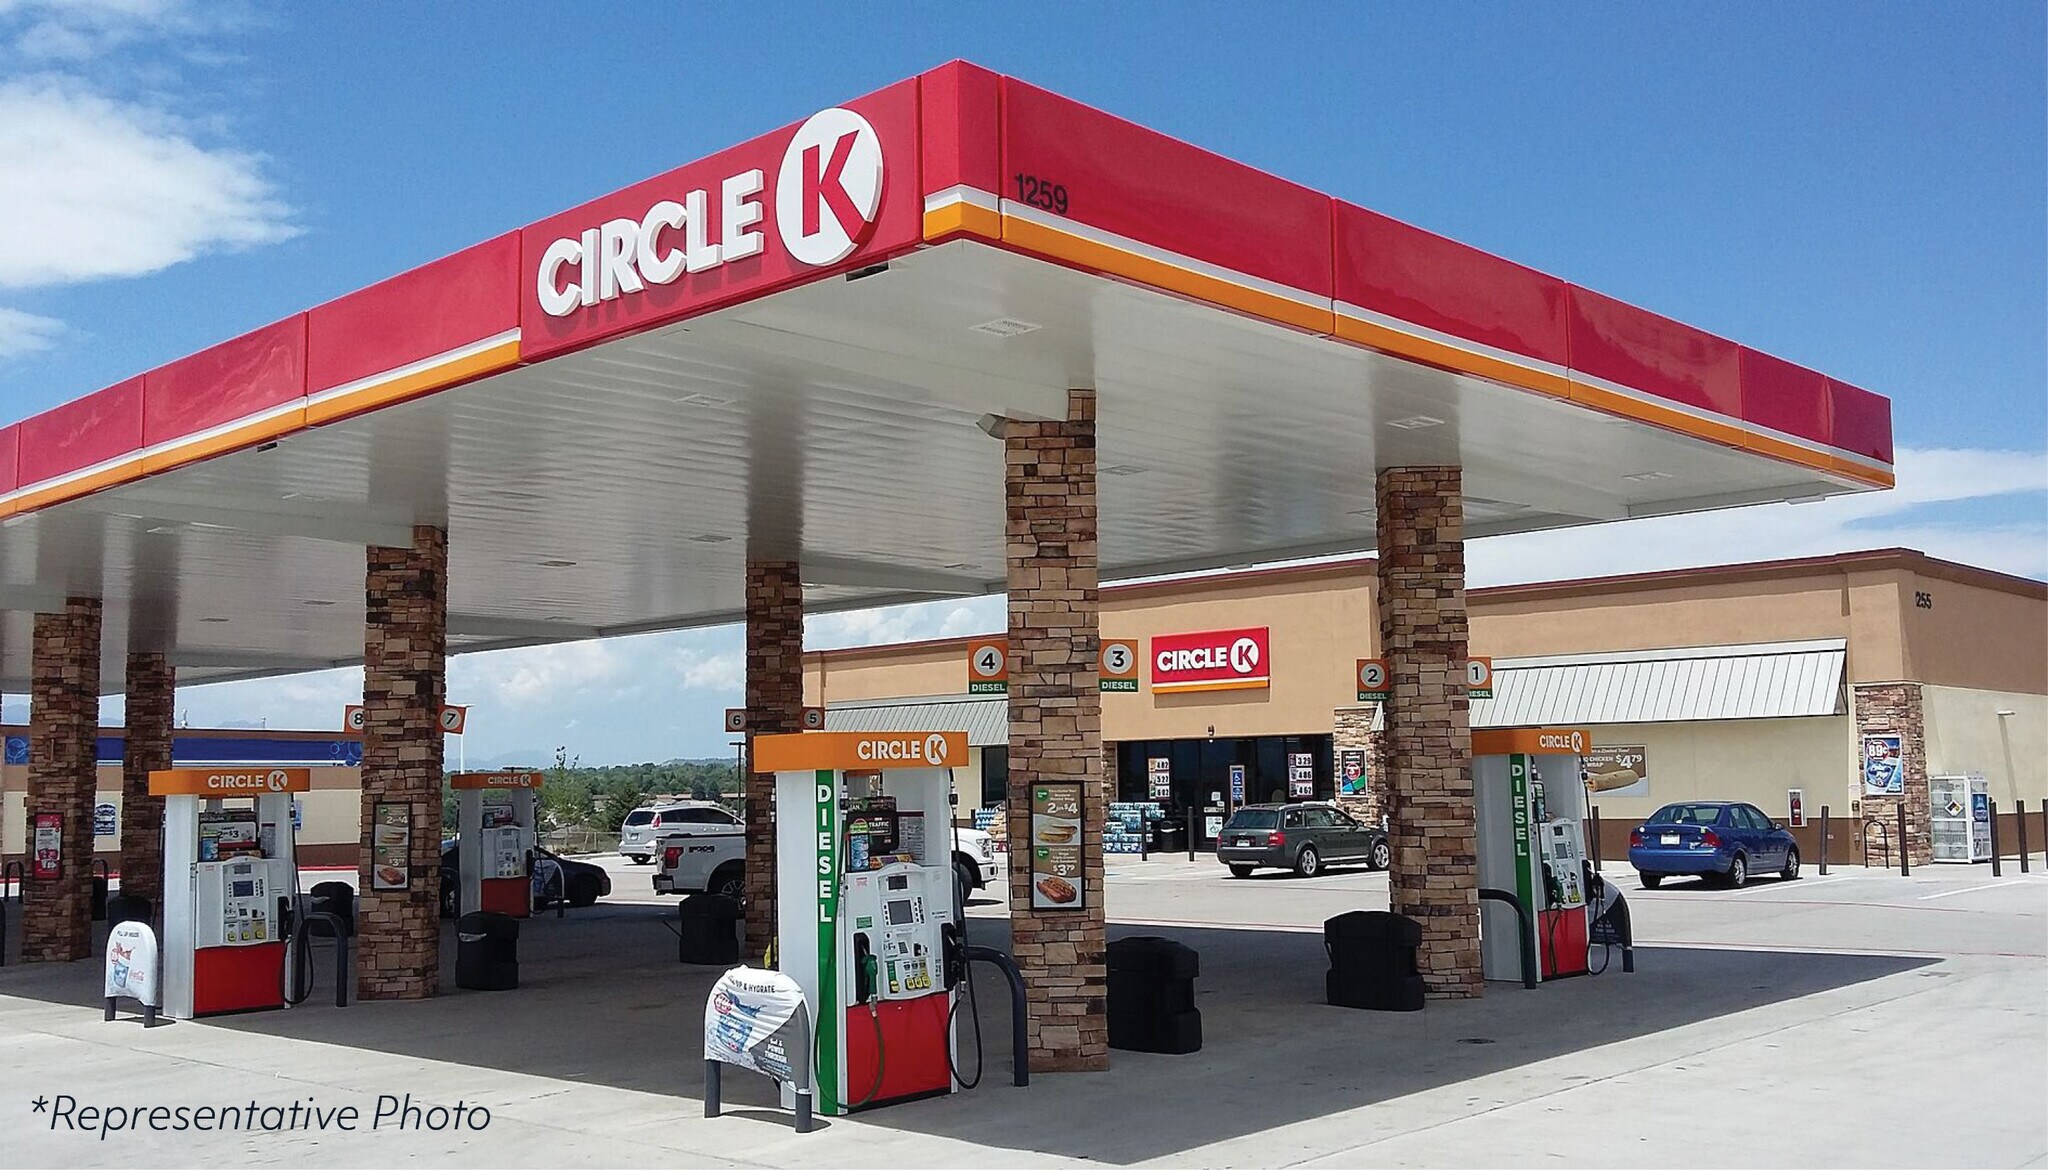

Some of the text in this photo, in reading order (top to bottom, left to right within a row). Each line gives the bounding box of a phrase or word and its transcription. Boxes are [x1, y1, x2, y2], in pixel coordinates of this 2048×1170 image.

[1013, 173, 1069, 215] 1259
[537, 126, 875, 317] CIRCLE K
[1915, 591, 1932, 610] 255
[980, 652, 996, 670] 4
[1111, 650, 1125, 668] 3
[1157, 646, 1227, 671] CIRCLE
[1367, 668, 1378, 682] 2
[1471, 666, 1479, 680] 1
[971, 682, 1006, 692] DIESEL
[1101, 681, 1136, 690] DIESEL
[1359, 692, 1387, 700] DIESEL
[1469, 690, 1491, 698] IESEL
[353, 713, 364, 725] 8
[445, 713, 457, 725] 7
[732, 714, 741, 725] 6
[808, 713, 818, 724] 5
[1539, 735, 1570, 748] CIRCLE
[857, 740, 921, 760] CIRCLE
[208, 775, 264, 788] CIRCLE
[487, 776, 519, 785] CIRCLE
[1047, 802, 1056, 813] 2
[1064, 802, 1078, 814] $4
[1511, 764, 1528, 857] DIESEL
[386, 816, 393, 824] 2
[868, 821, 890, 832] TRAFFIC
[817, 784, 833, 923] DIESEL
[748, 984, 776, 993] HYDRATE
